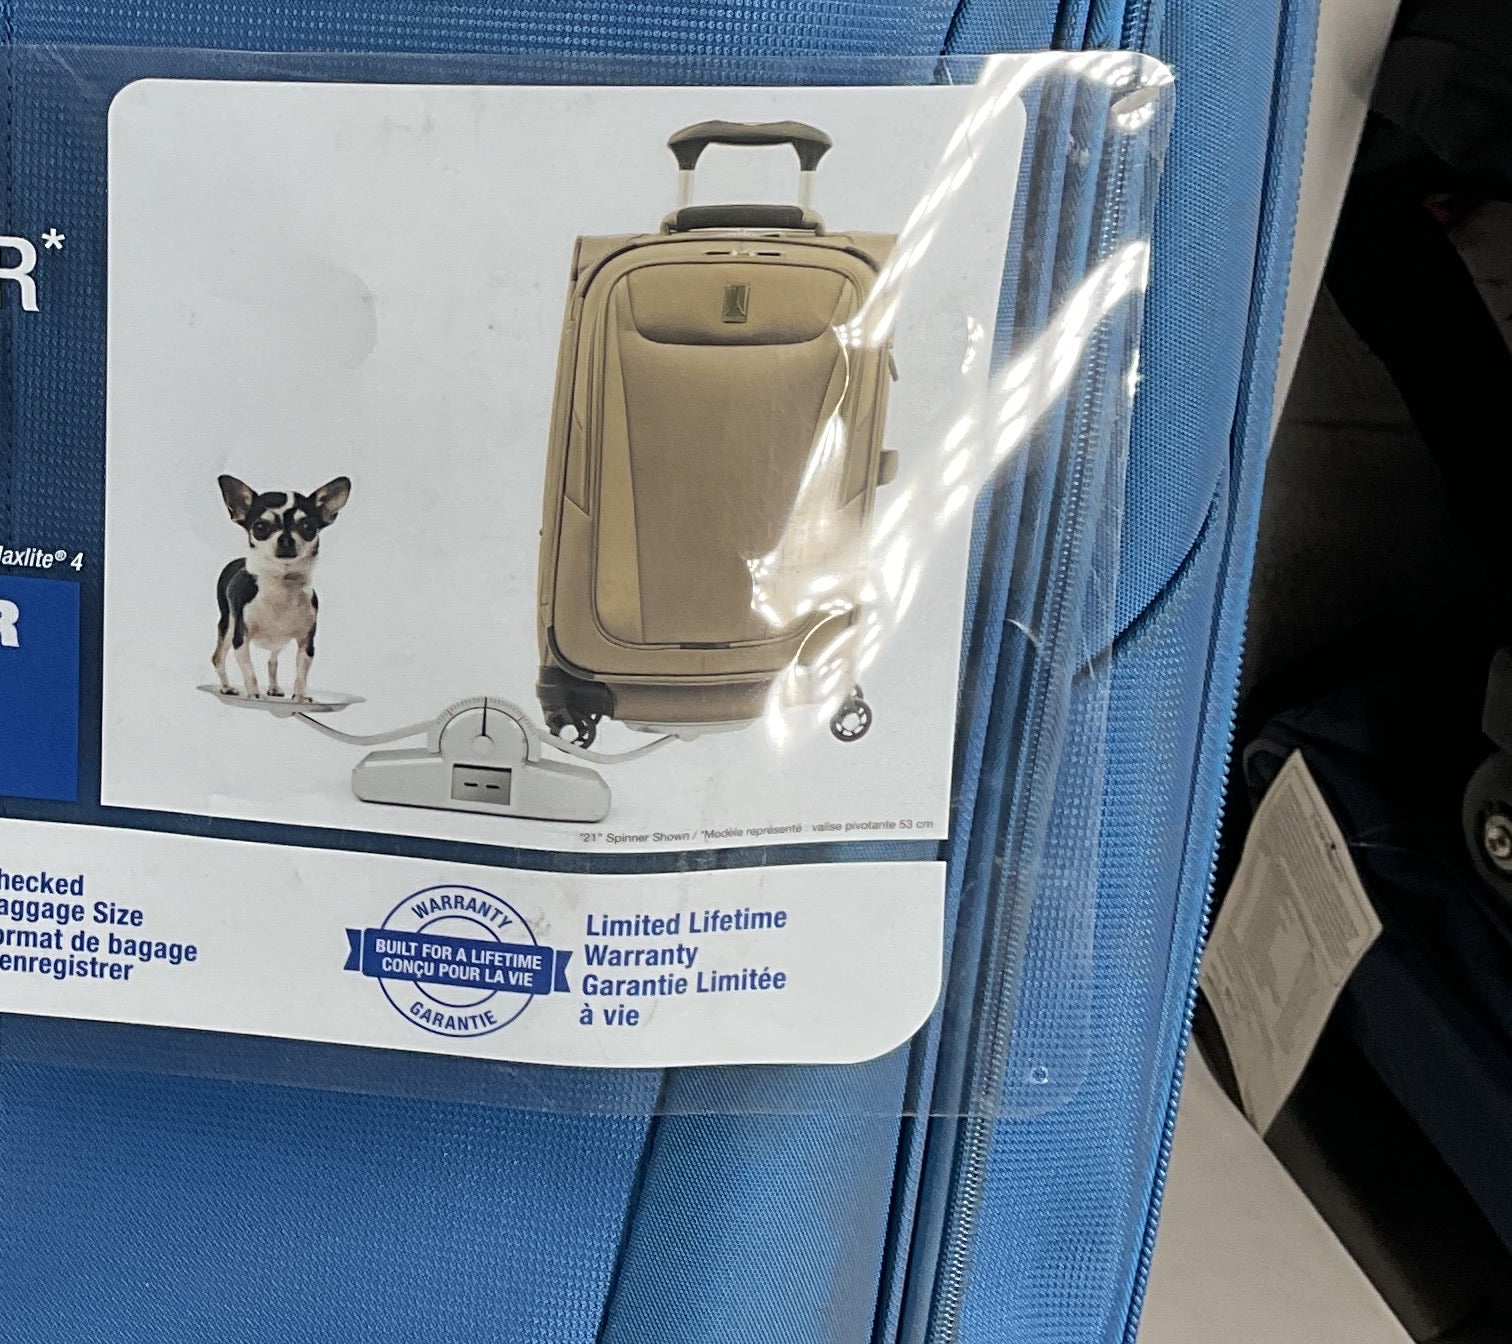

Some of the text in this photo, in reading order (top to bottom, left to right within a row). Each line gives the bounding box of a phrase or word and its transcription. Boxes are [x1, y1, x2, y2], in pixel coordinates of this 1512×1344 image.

[70, 552, 84, 572] 4
[606, 833, 649, 845] Spinner
[652, 831, 691, 843] Shown
[812, 821, 843, 832] valise
[845, 819, 896, 833] pivotante
[899, 819, 914, 830] 53
[915, 820, 934, 830] cm
[93, 901, 144, 927] Size
[411, 894, 513, 930] WARRANTY
[586, 907, 788, 937] Limited Lifetime
[71, 928, 99, 953] de
[108, 933, 198, 964] bagage
[375, 938, 542, 970] BUILT FOR A LIFETIME
[584, 942, 699, 968] Warranty
[0, 952, 133, 981] enregistrer
[381, 956, 534, 987] CONÇU POUR LA VIE
[581, 966, 787, 997] Garantie Limitée
[409, 1000, 499, 1031] GARANTIE
[579, 1001, 640, 1027] à vie
